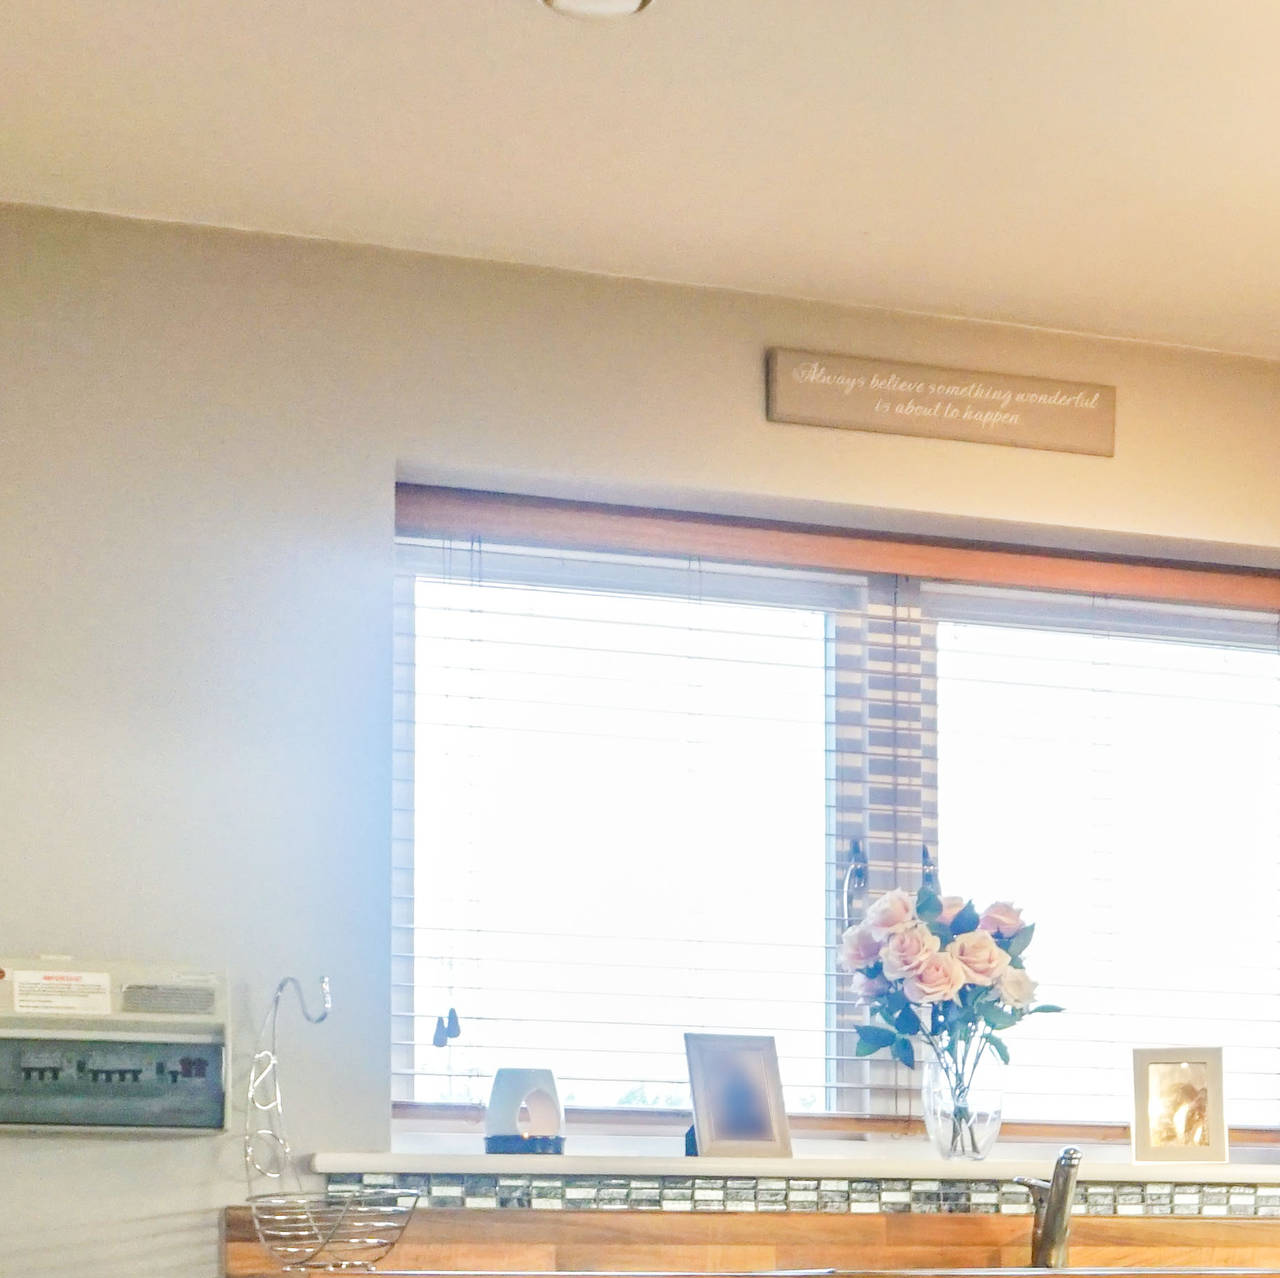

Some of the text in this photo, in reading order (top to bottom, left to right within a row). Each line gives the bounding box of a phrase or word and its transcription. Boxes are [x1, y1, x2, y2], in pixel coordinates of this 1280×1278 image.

[792, 361, 1101, 409] Always believe something wonderful
[874, 399, 890, 413] is
[895, 399, 942, 417] about
[944, 402, 960, 417] to
